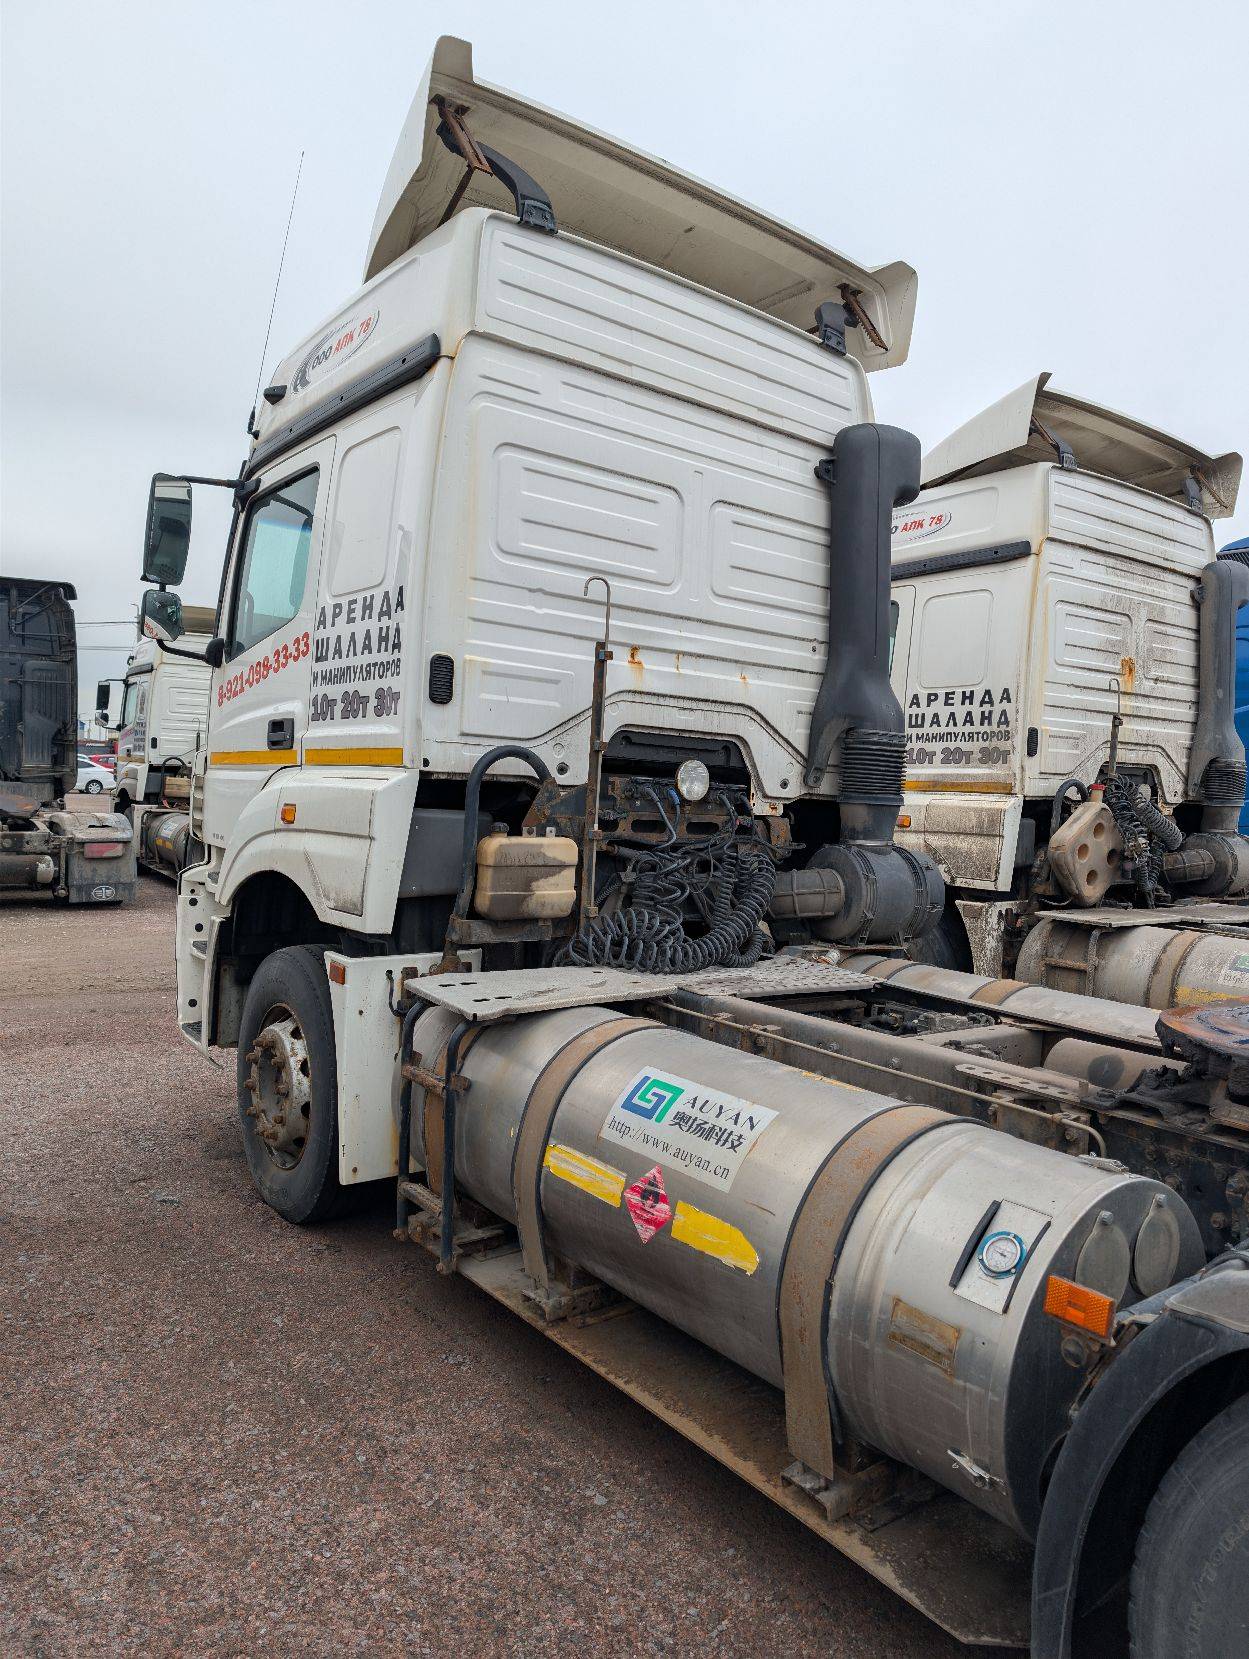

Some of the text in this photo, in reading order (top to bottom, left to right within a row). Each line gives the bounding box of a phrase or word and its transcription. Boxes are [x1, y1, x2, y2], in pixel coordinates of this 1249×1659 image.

[901, 519, 925, 532] АПК
[929, 514, 944, 526] 78
[316, 585, 405, 631] АРЕНДА
[218, 632, 310, 707] 8-921-098-33-33
[312, 658, 401, 687] И МАНИПУЛЯТОРОВ
[909, 687, 1012, 708] АРЕНДА
[908, 709, 1010, 728] ШАЛАНД
[905, 730, 1011, 744] И МАНИПУЛЯТОРОВ
[683, 1096, 761, 1132] AUYAN
[608, 1115, 731, 1181] http://www.auyan.cn
[669, 1110, 747, 1154] 奥扬科技
